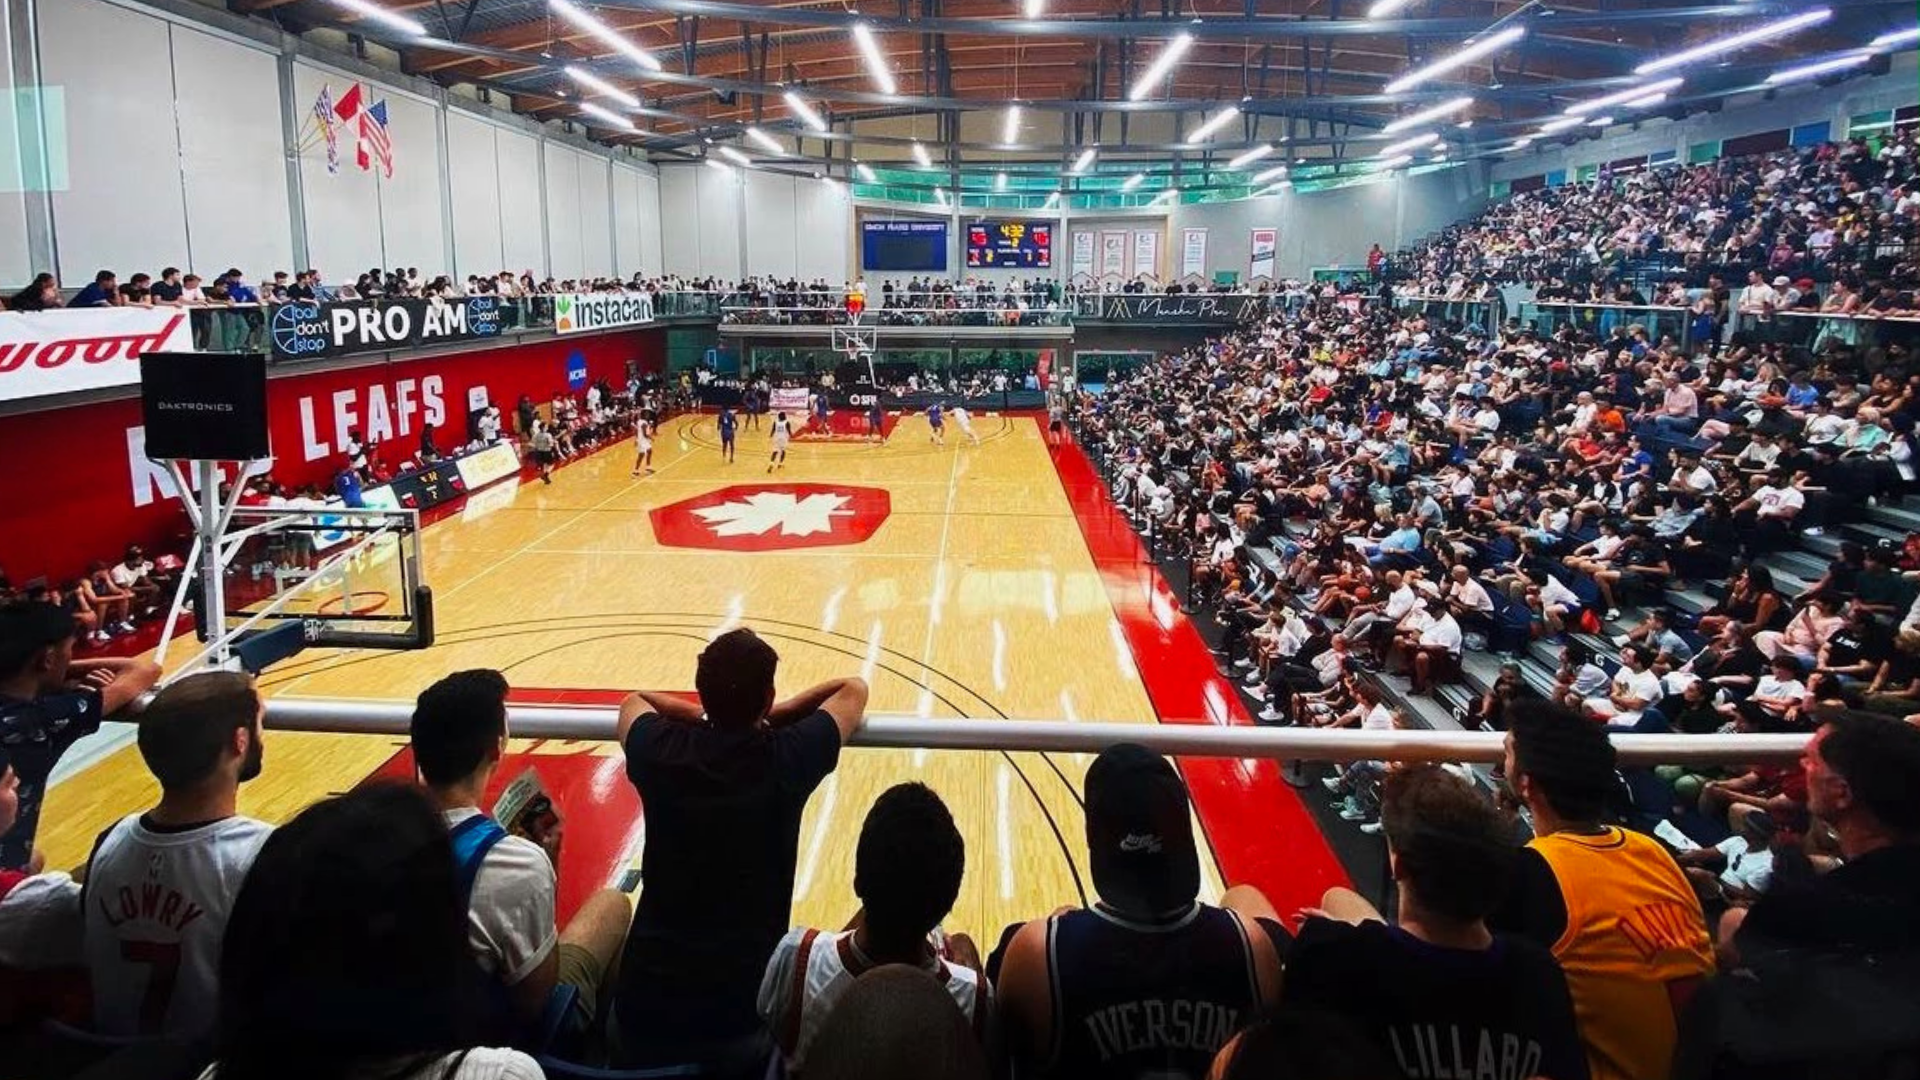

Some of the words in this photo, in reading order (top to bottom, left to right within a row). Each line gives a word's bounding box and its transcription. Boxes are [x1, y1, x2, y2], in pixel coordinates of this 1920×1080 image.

[294, 304, 318, 320] ball
[296, 318, 330, 336] don't
[331, 306, 411, 347] PRO
[422, 302, 468, 337] AM
[297, 338, 326, 353] stop
[158, 401, 234, 411] DAKTRONICS
[299, 374, 446, 462] LEAFS
[100, 882, 204, 932] LOWRY
[121, 939, 182, 1034] 7
[1084, 997, 1241, 1063] IVERSON
